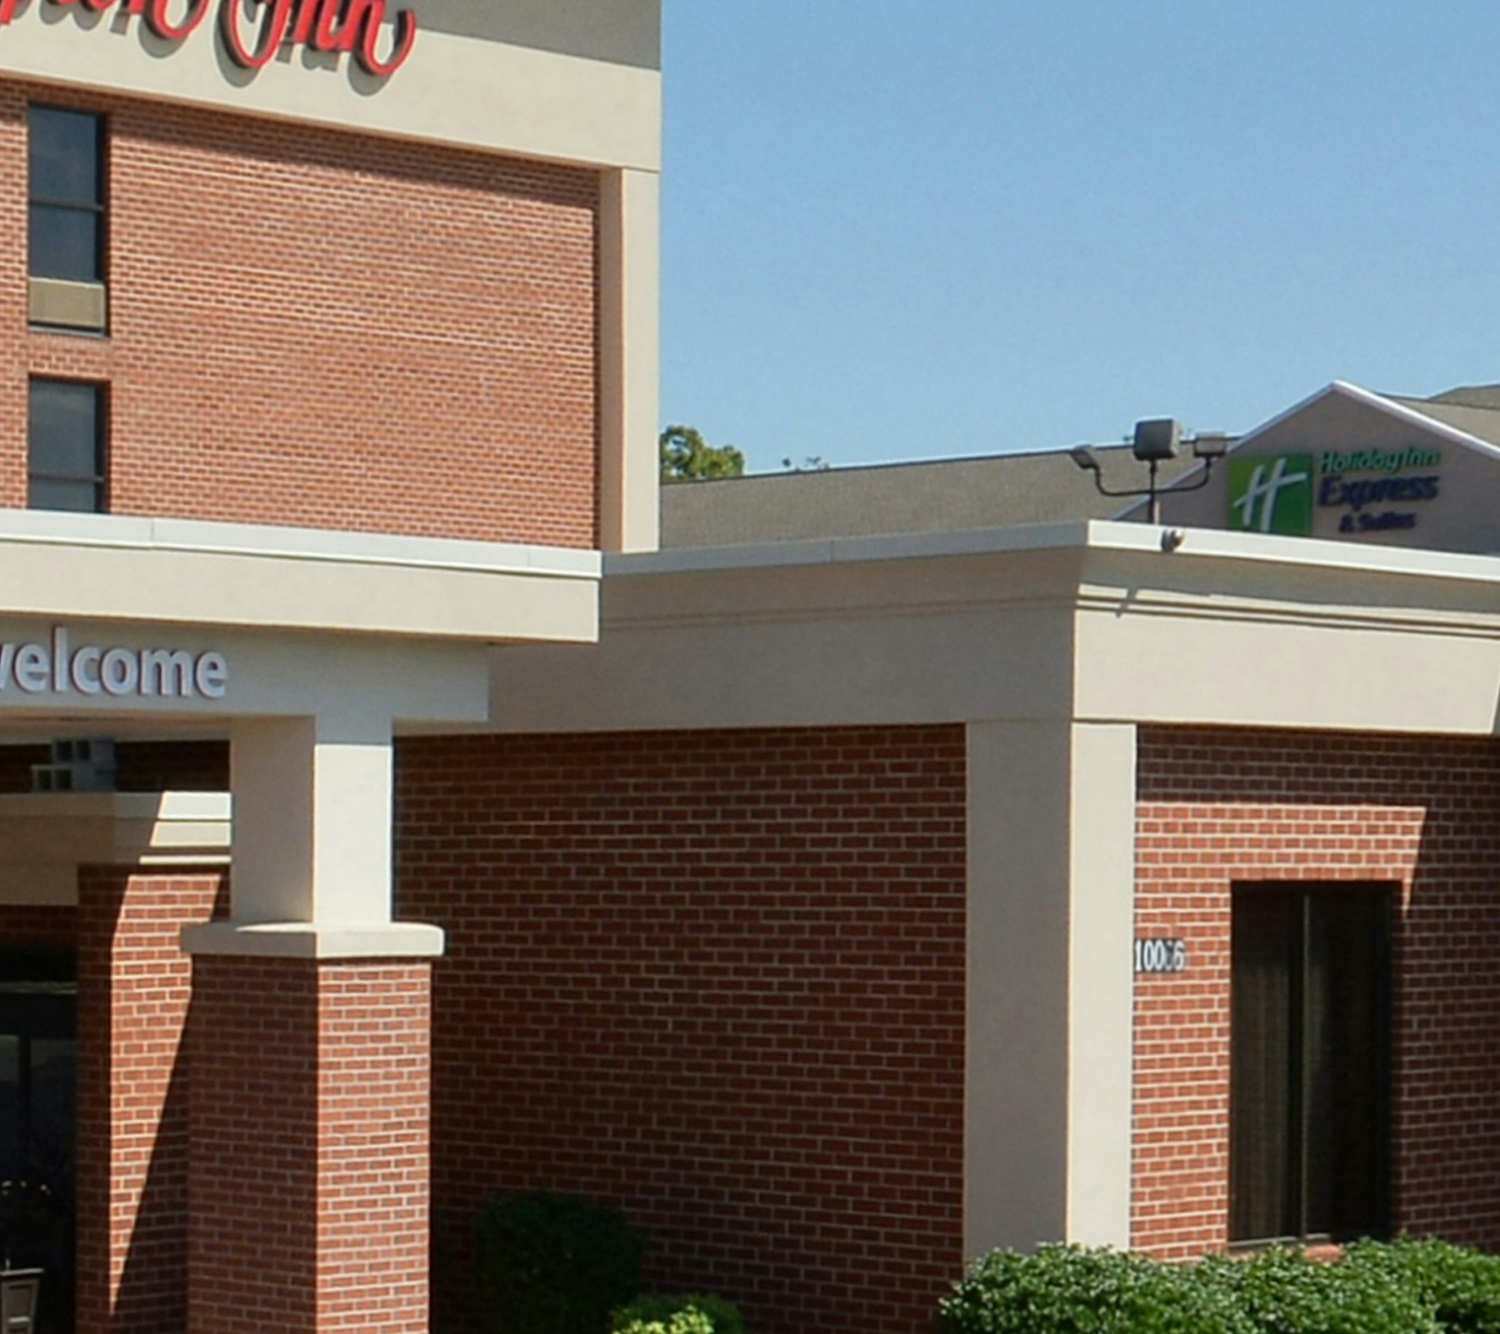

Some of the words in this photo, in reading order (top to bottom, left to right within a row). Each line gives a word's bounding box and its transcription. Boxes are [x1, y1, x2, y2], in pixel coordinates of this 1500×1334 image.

[1320, 449, 1402, 473] Holiday
[1402, 445, 1441, 465] Inn
[1318, 474, 1440, 511] Express
